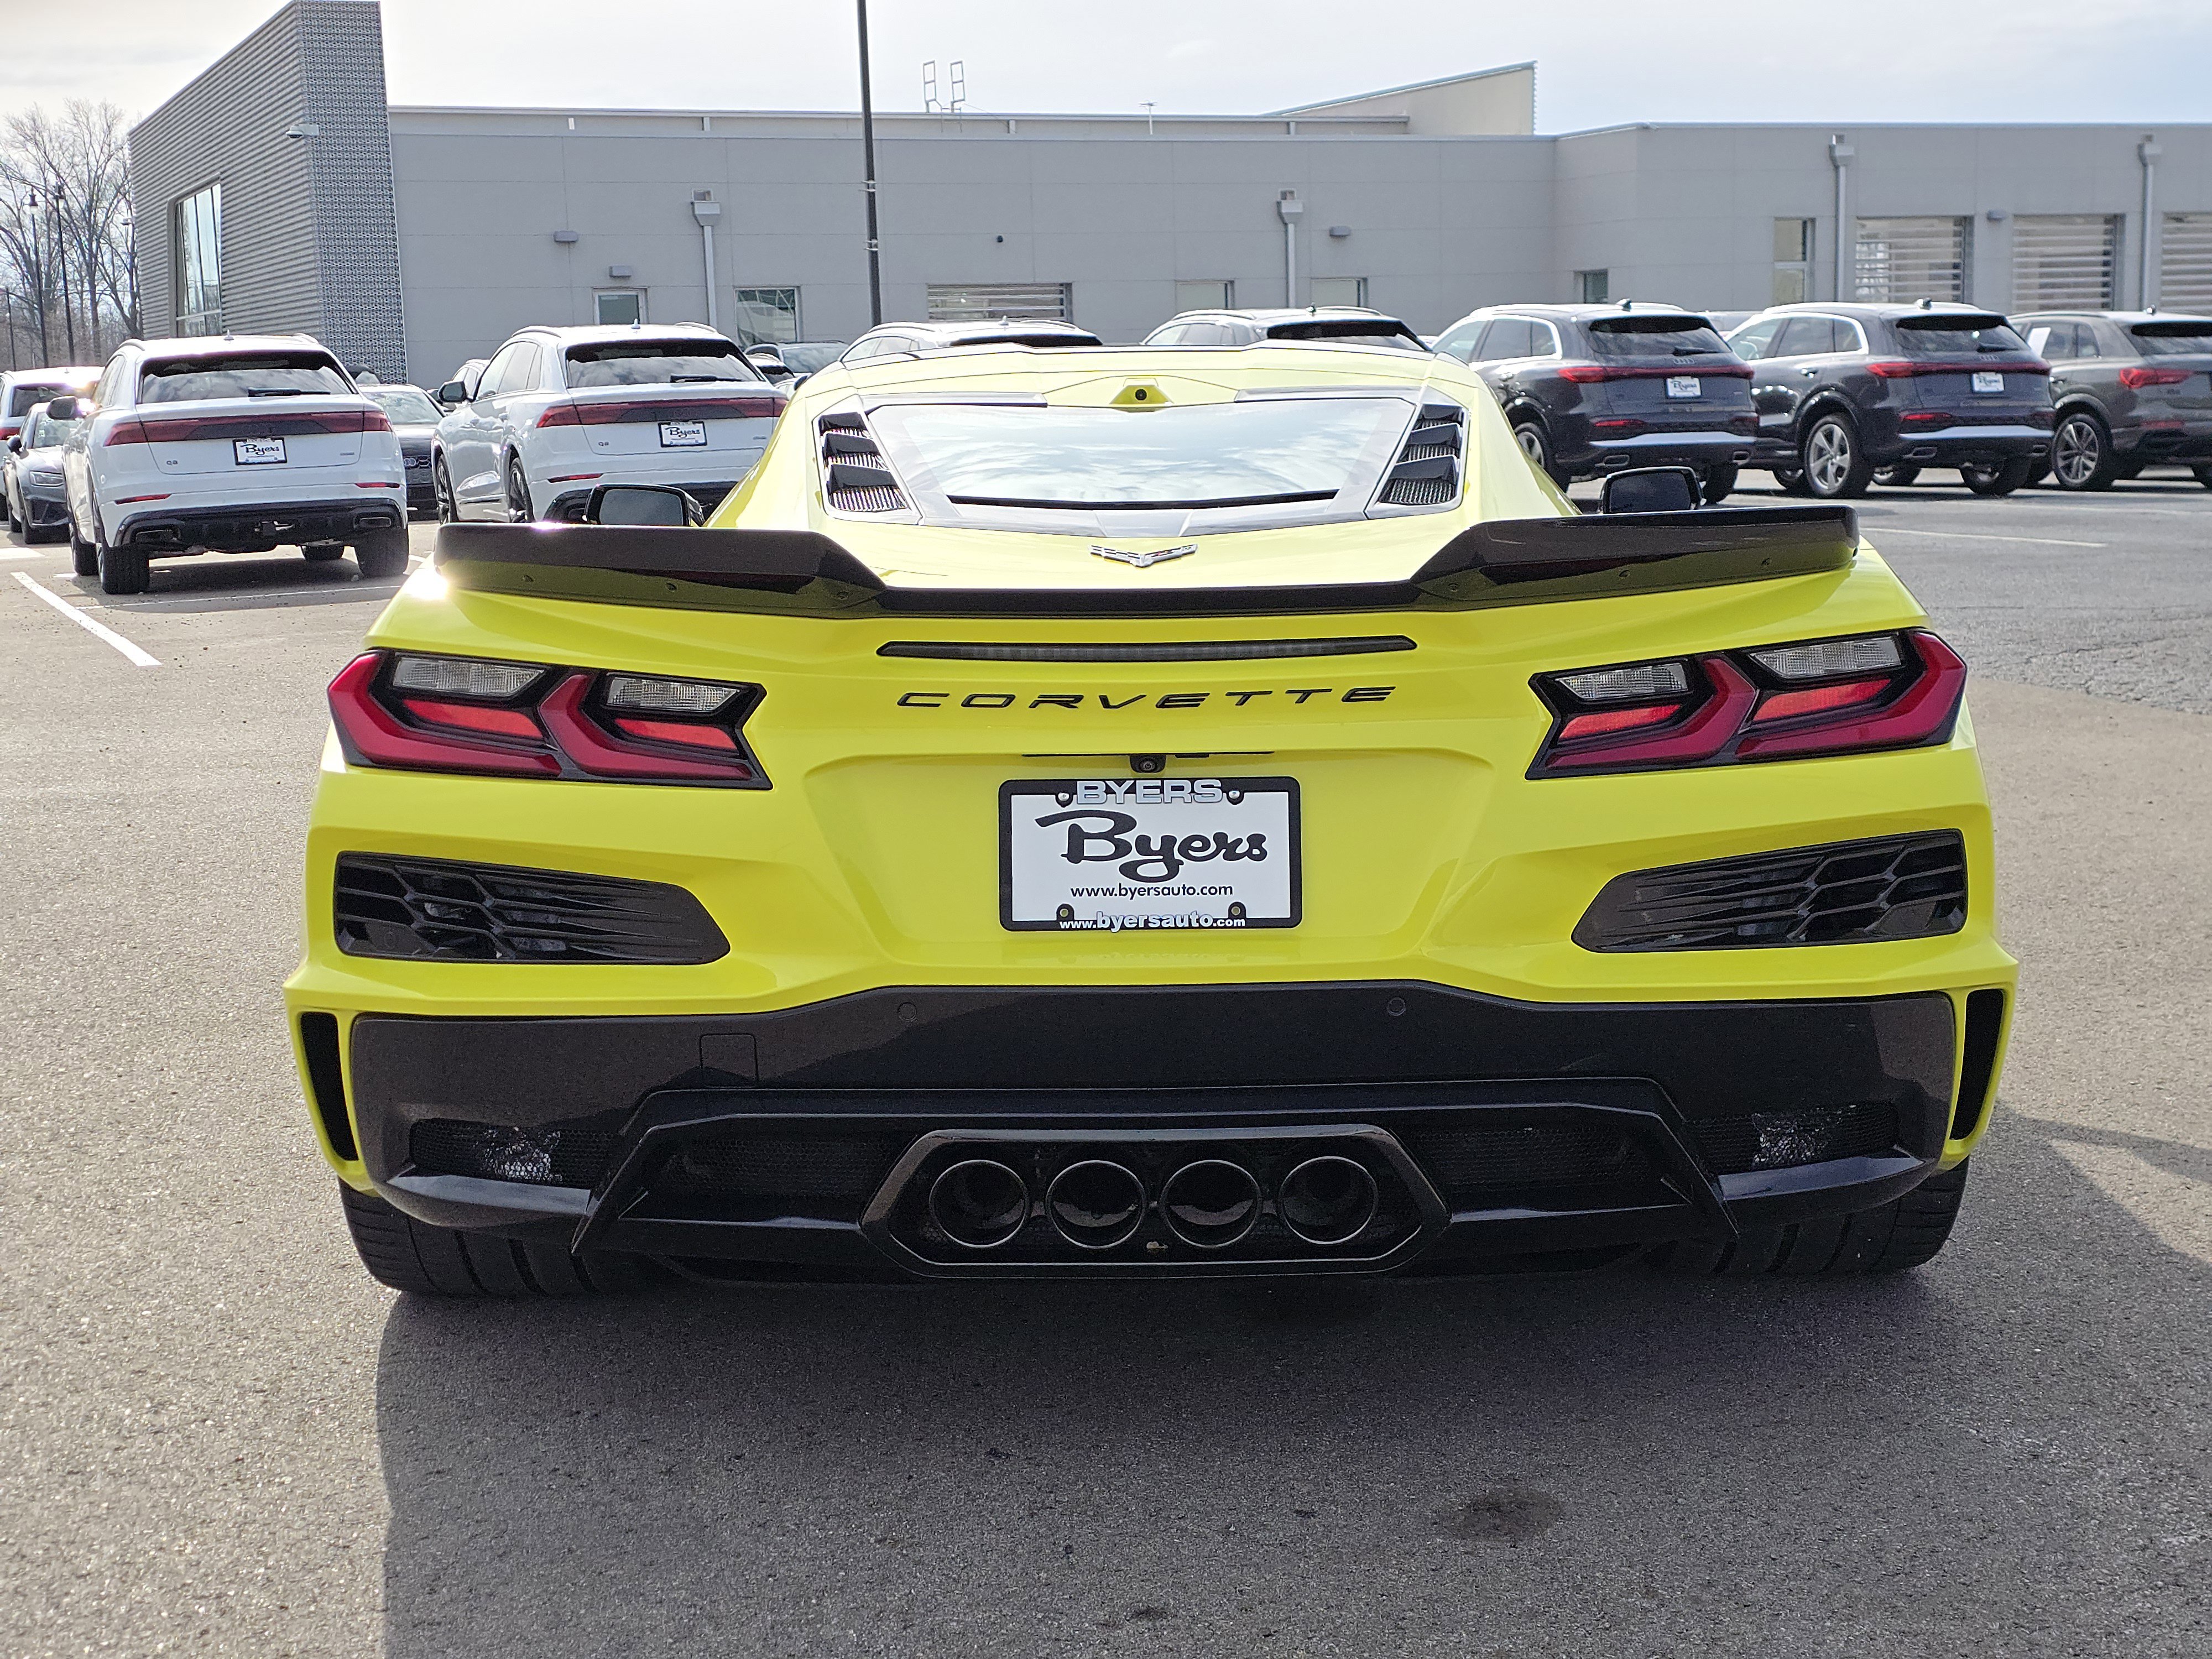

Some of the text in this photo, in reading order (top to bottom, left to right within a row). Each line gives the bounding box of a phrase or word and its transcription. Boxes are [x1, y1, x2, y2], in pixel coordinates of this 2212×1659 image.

[240, 444, 279, 456] Byers
[896, 686, 1396, 709] CORVETTE
[1076, 779, 1223, 805] BYERS
[1035, 810, 1268, 883] Byers
[1071, 883, 1233, 900] www.byersauto.com
[1059, 911, 1246, 932] www.byersauto.com
